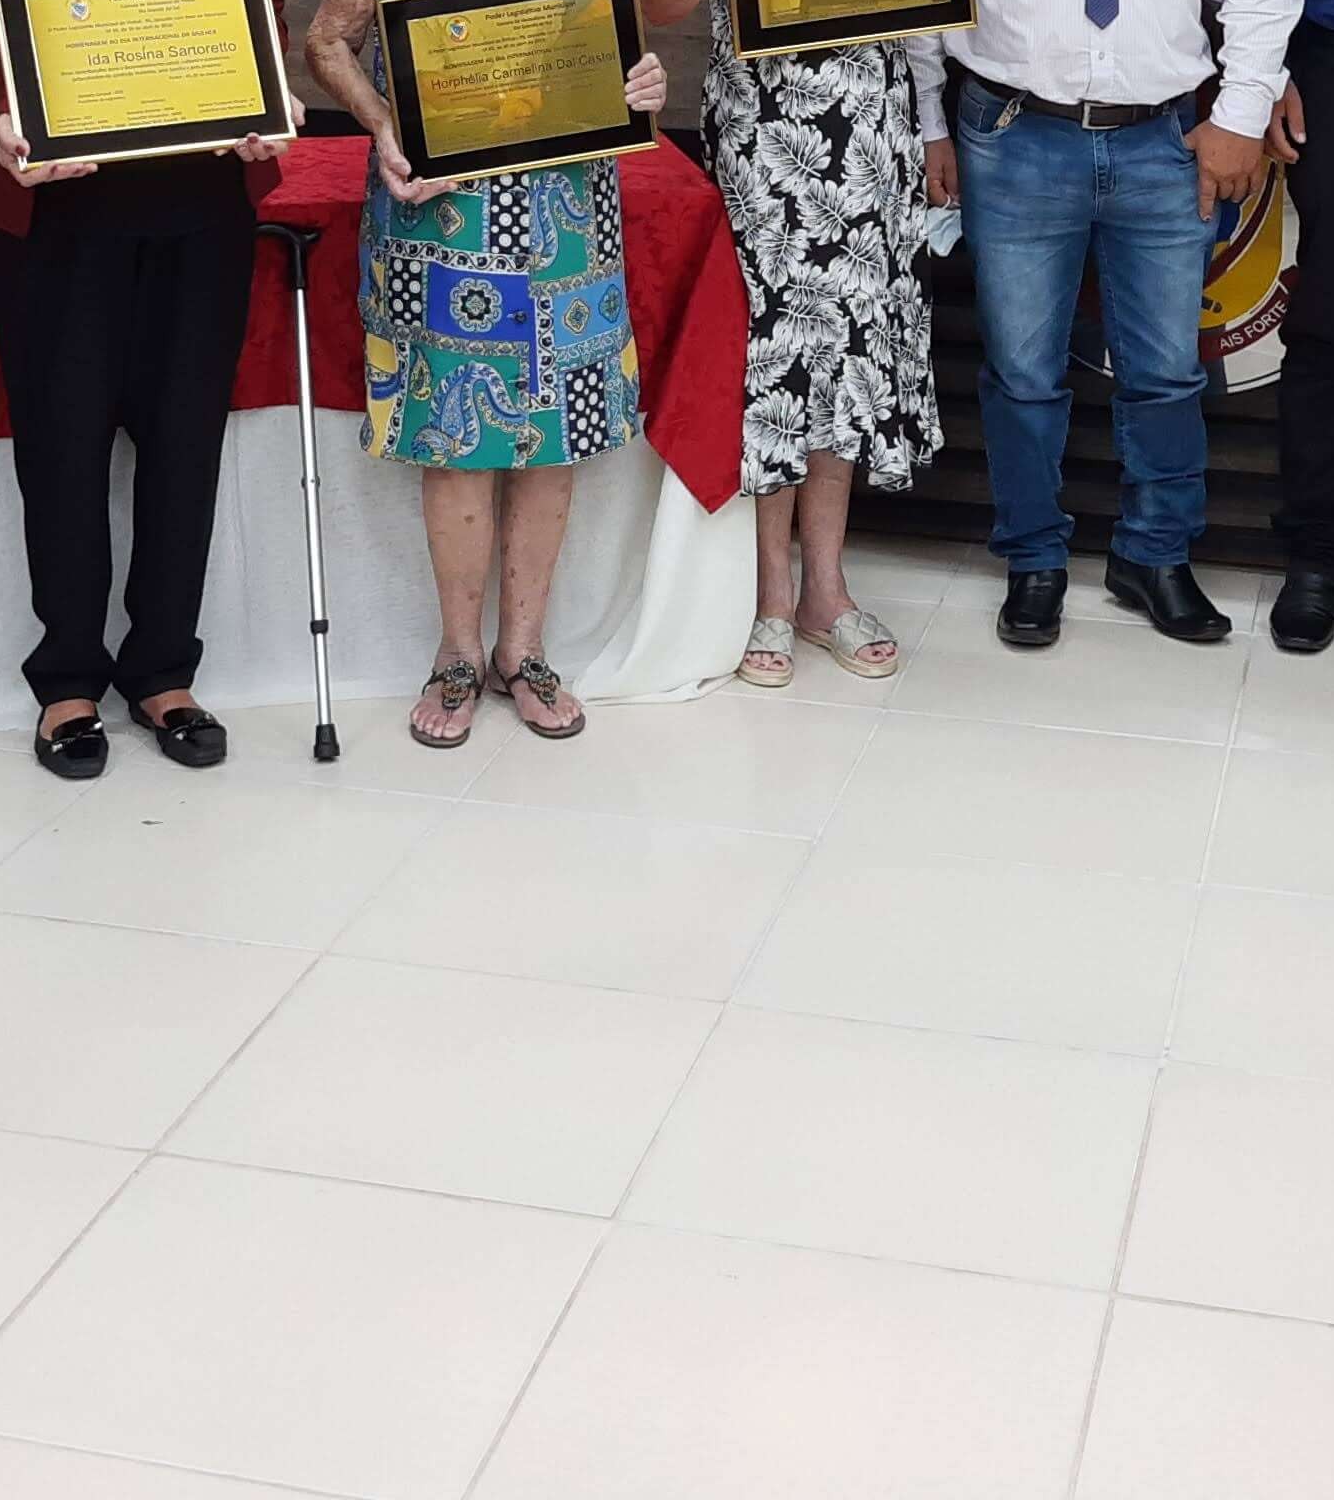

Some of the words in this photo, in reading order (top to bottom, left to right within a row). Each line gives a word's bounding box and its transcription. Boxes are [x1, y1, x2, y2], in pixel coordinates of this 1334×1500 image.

[87, 53, 110, 67] Ida
[168, 41, 237, 58] Sartoretto
[492, 61, 553, 80] Carmelina
[1244, 300, 1287, 338] FORTE
